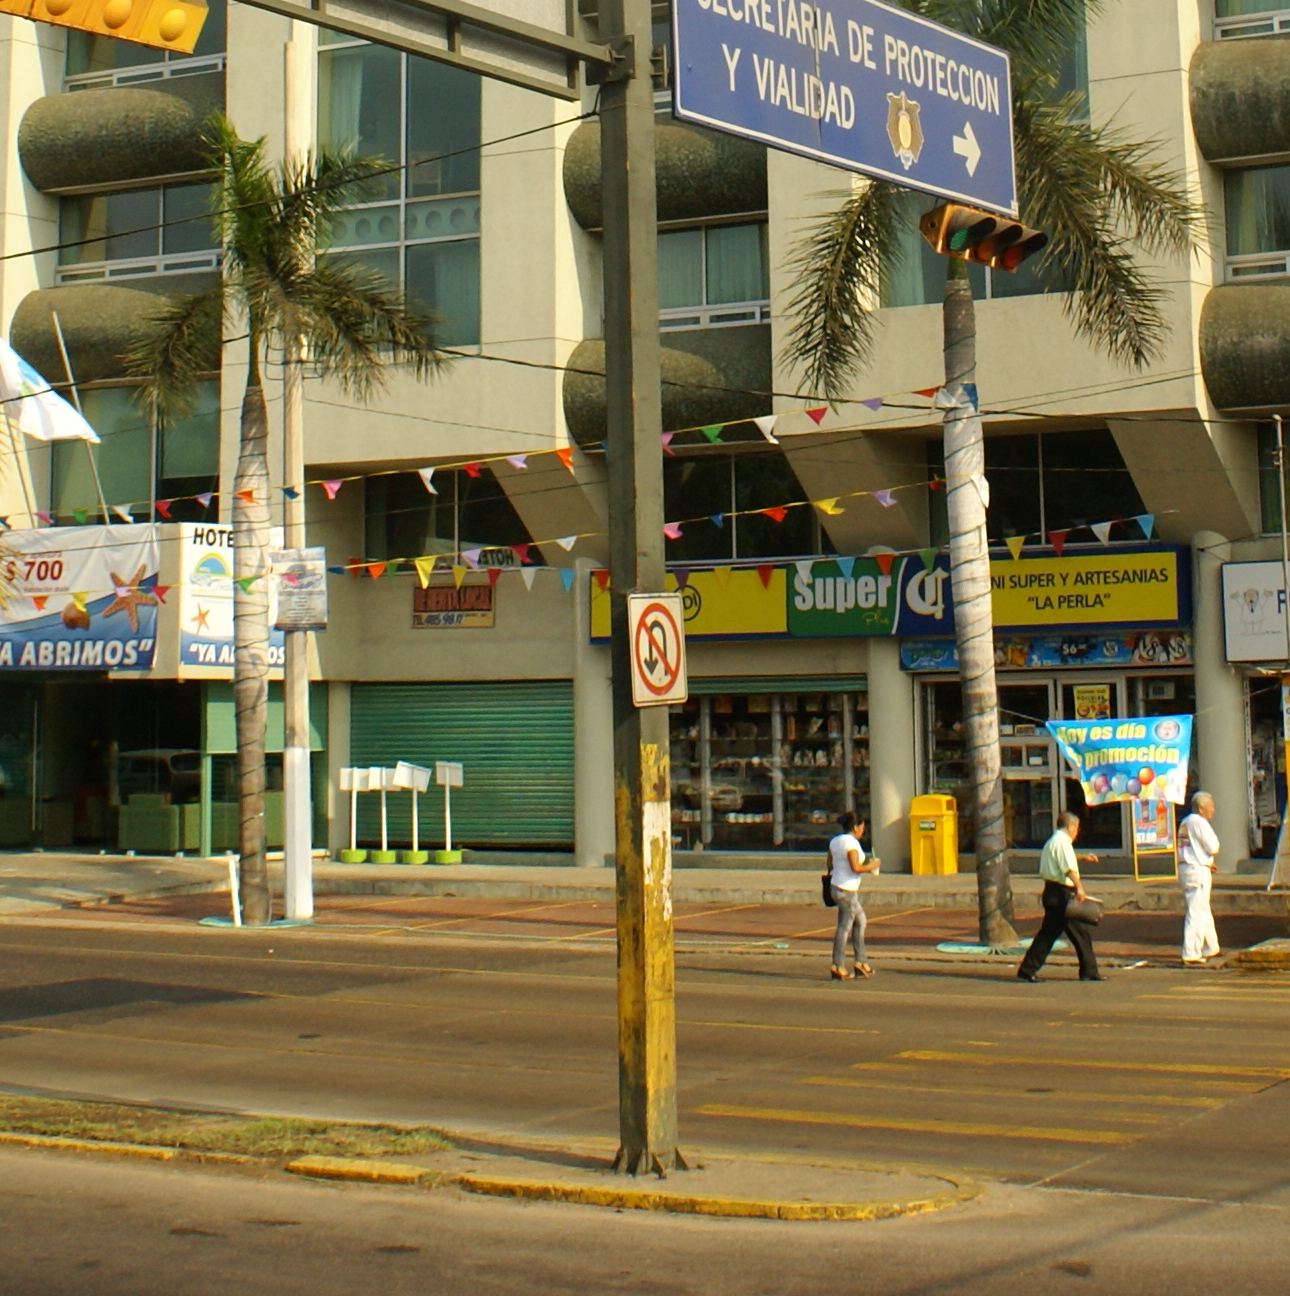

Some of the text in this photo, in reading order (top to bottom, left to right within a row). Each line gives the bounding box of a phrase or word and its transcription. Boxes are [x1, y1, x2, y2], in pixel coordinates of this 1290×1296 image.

[847, 20, 877, 71] DE
[884, 34, 1001, 116] PROTECCION
[721, 43, 855, 130] Y VIALIDAD
[193, 526, 235, 548] HOTE
[24, 559, 63, 581] 700
[1010, 573, 1055, 589] SUPER
[1059, 571, 1070, 587] Y
[1073, 567, 1169, 586] ARTESANIAS
[794, 571, 892, 614] Super
[18, 637, 154, 668] ABRIMOS"
[1090, 726, 1113, 740] es
[1115, 722, 1147, 740] día
[1084, 744, 1180, 771] promoción
